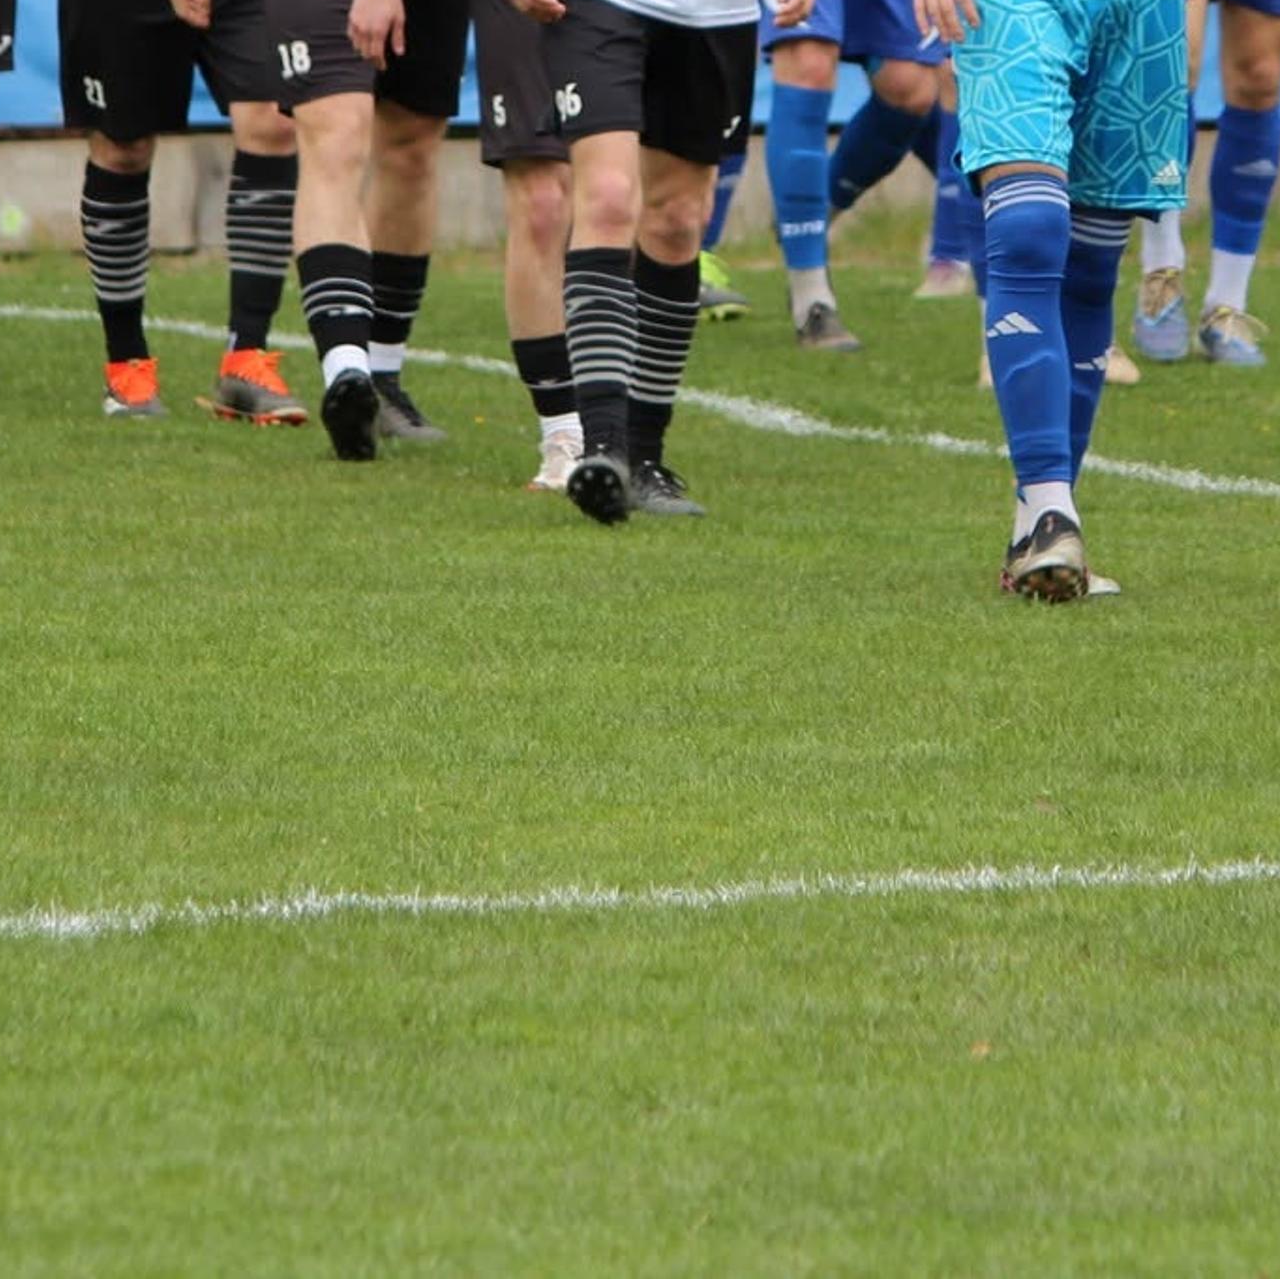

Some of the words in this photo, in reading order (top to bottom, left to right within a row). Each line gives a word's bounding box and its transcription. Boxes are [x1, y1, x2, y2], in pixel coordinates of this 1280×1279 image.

[277, 40, 311, 80] 18
[492, 94, 507, 127] 5
[555, 82, 582, 123] 96
